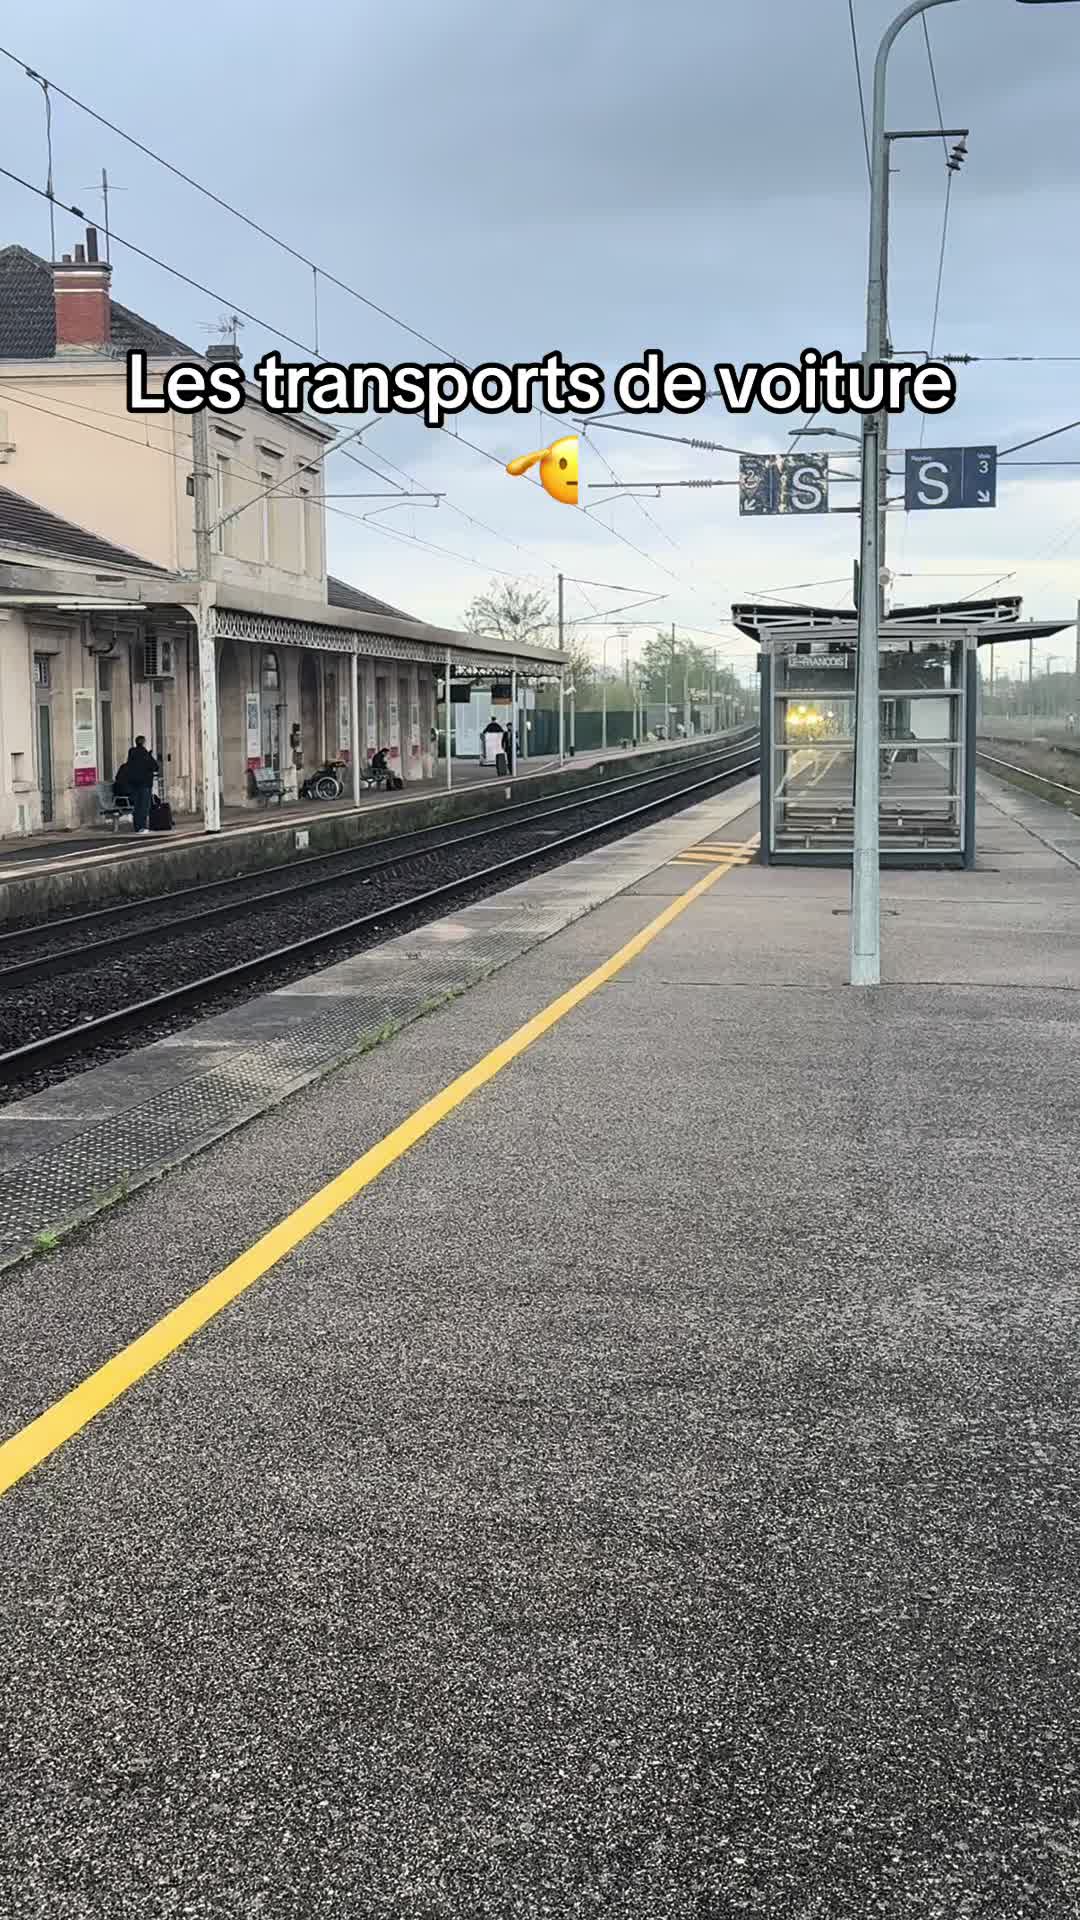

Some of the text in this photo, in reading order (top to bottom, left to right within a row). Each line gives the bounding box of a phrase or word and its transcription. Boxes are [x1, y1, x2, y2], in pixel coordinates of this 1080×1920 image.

[917, 461, 949, 505] S
[979, 460, 989, 473] 3
[791, 467, 821, 510] S
